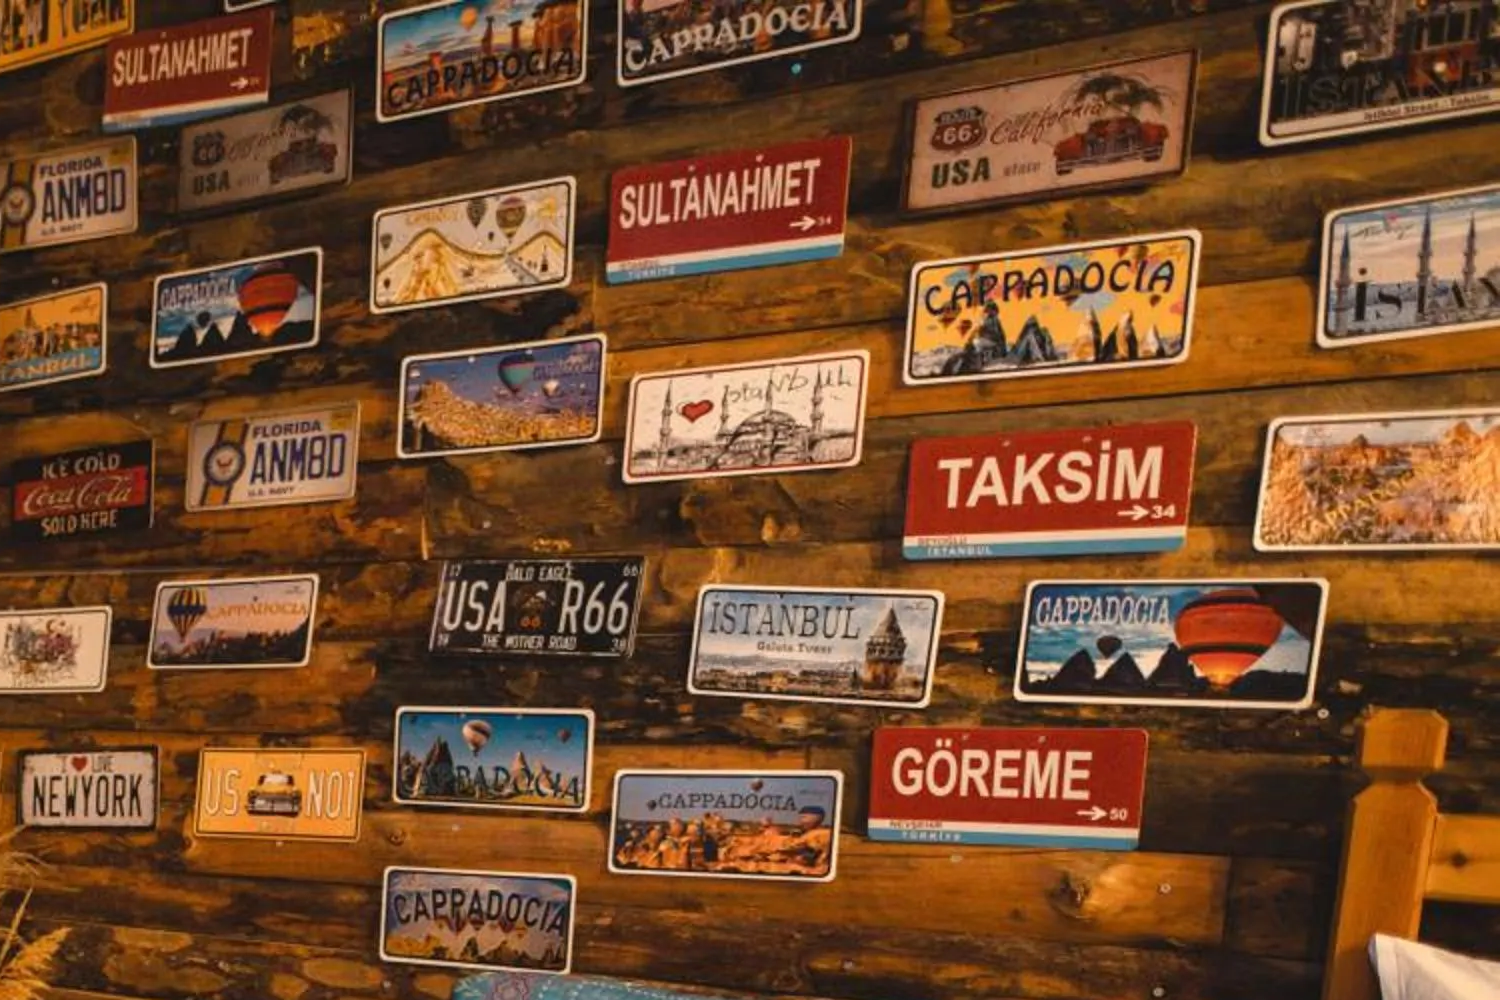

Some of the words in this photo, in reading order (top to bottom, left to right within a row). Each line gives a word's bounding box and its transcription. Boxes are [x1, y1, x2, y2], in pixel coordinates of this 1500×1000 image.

[624, 1, 849, 71] CAPPADOCIA
[112, 28, 253, 87] SULTANAHMET
[387, 47, 575, 108] CAPPADOCIA
[941, 124, 972, 145] 66
[39, 156, 104, 179] FLORIDA
[192, 170, 231, 196] USA
[931, 156, 991, 189] USA
[619, 158, 822, 229] SULTANAHMET
[924, 259, 1176, 316] CAPPADOCIA
[251, 419, 322, 439] FLORIDA
[42, 457, 71, 480] ICE
[74, 451, 121, 475] COLD
[937, 439, 1165, 509] TAKSİM
[40, 514, 78, 537] SOLD
[81, 508, 119, 529] HERE
[1151, 504, 1176, 519] 34
[443, 579, 508, 633] USA
[557, 579, 630, 635] R66
[1035, 596, 1172, 627] CAPPADOCIA
[504, 634, 545, 650] MOTHER
[548, 634, 578, 650] ROAD
[890, 738, 1094, 801] GÖREME
[204, 768, 242, 817] US
[657, 791, 799, 812] CAPPADOCIA
[393, 888, 569, 938] CAPPADOCIA
